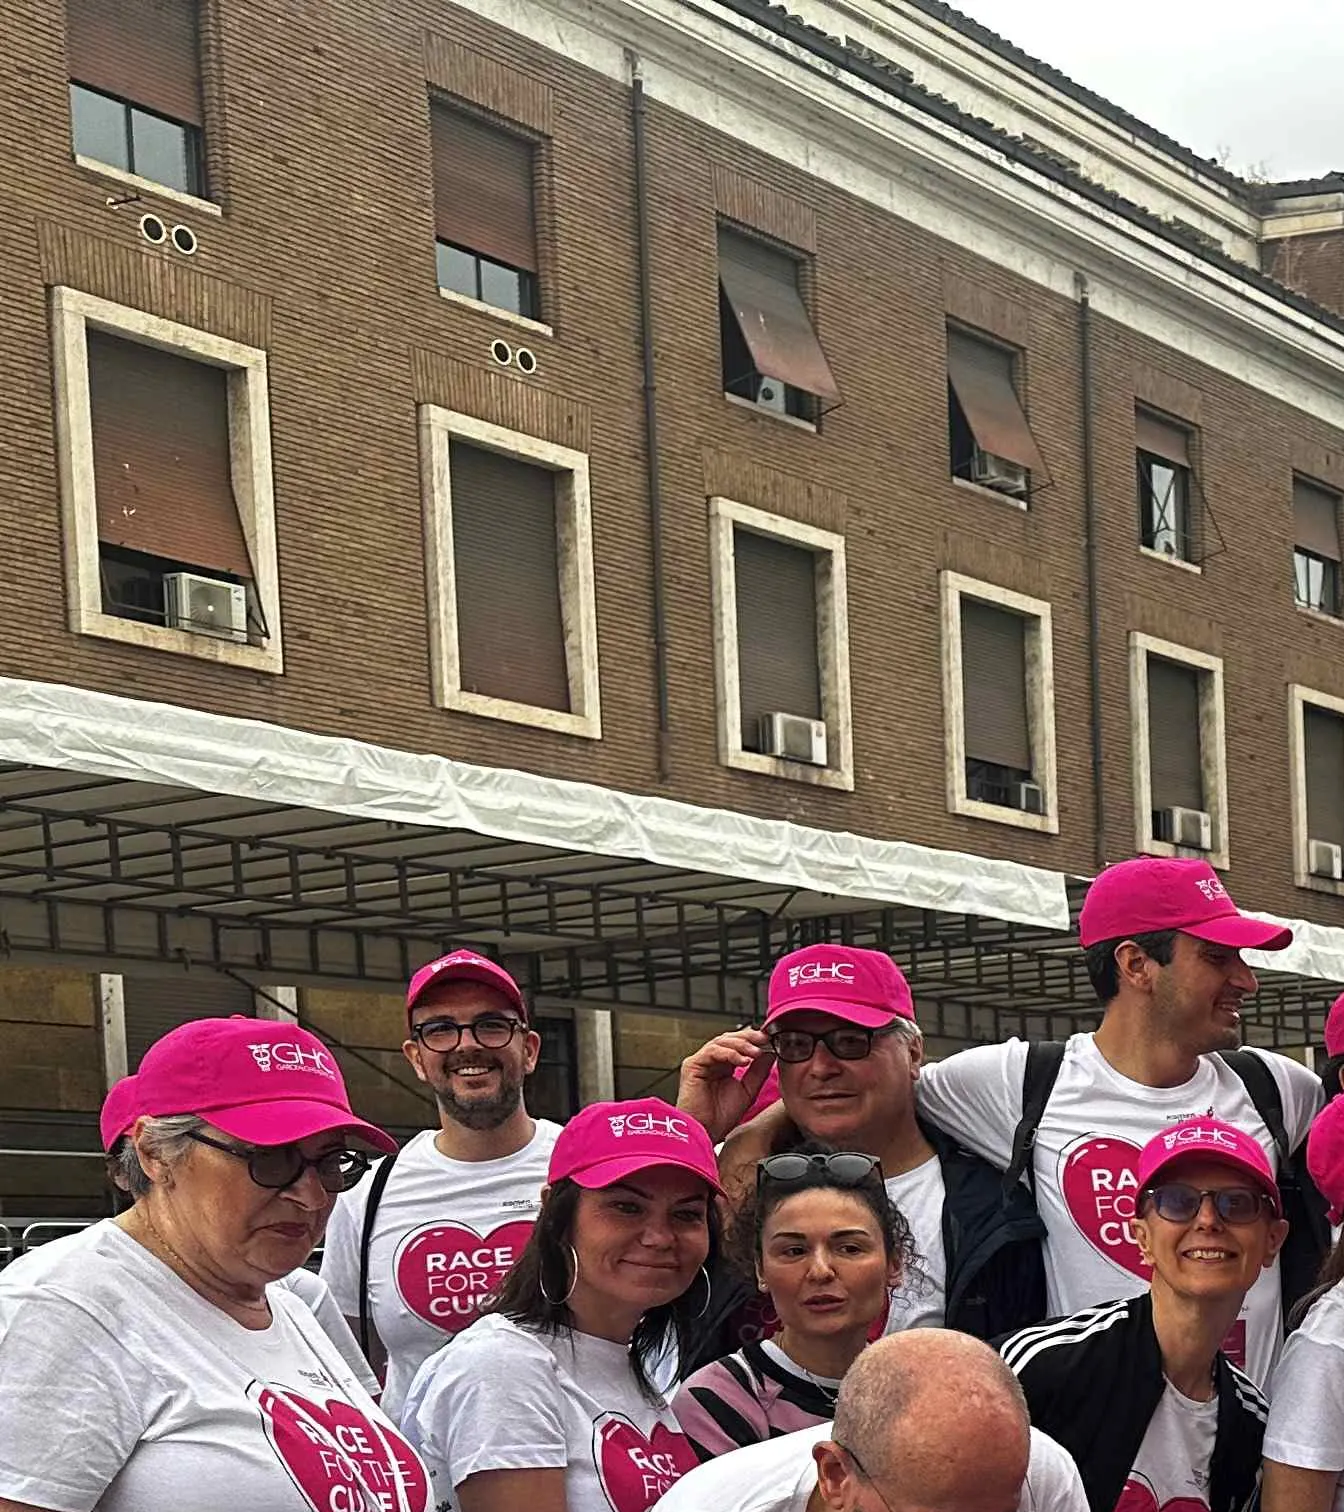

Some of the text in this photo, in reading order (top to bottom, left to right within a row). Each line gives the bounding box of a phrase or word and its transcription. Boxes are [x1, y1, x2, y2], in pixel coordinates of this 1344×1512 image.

[799, 961, 855, 981] GHC
[271, 1043, 335, 1076] GHC
[626, 1113, 690, 1144] GHC
[1178, 1126, 1240, 1149] GHC
[1095, 1194, 1136, 1219] FO
[427, 1246, 514, 1273] RACE
[428, 1271, 489, 1295] FOR
